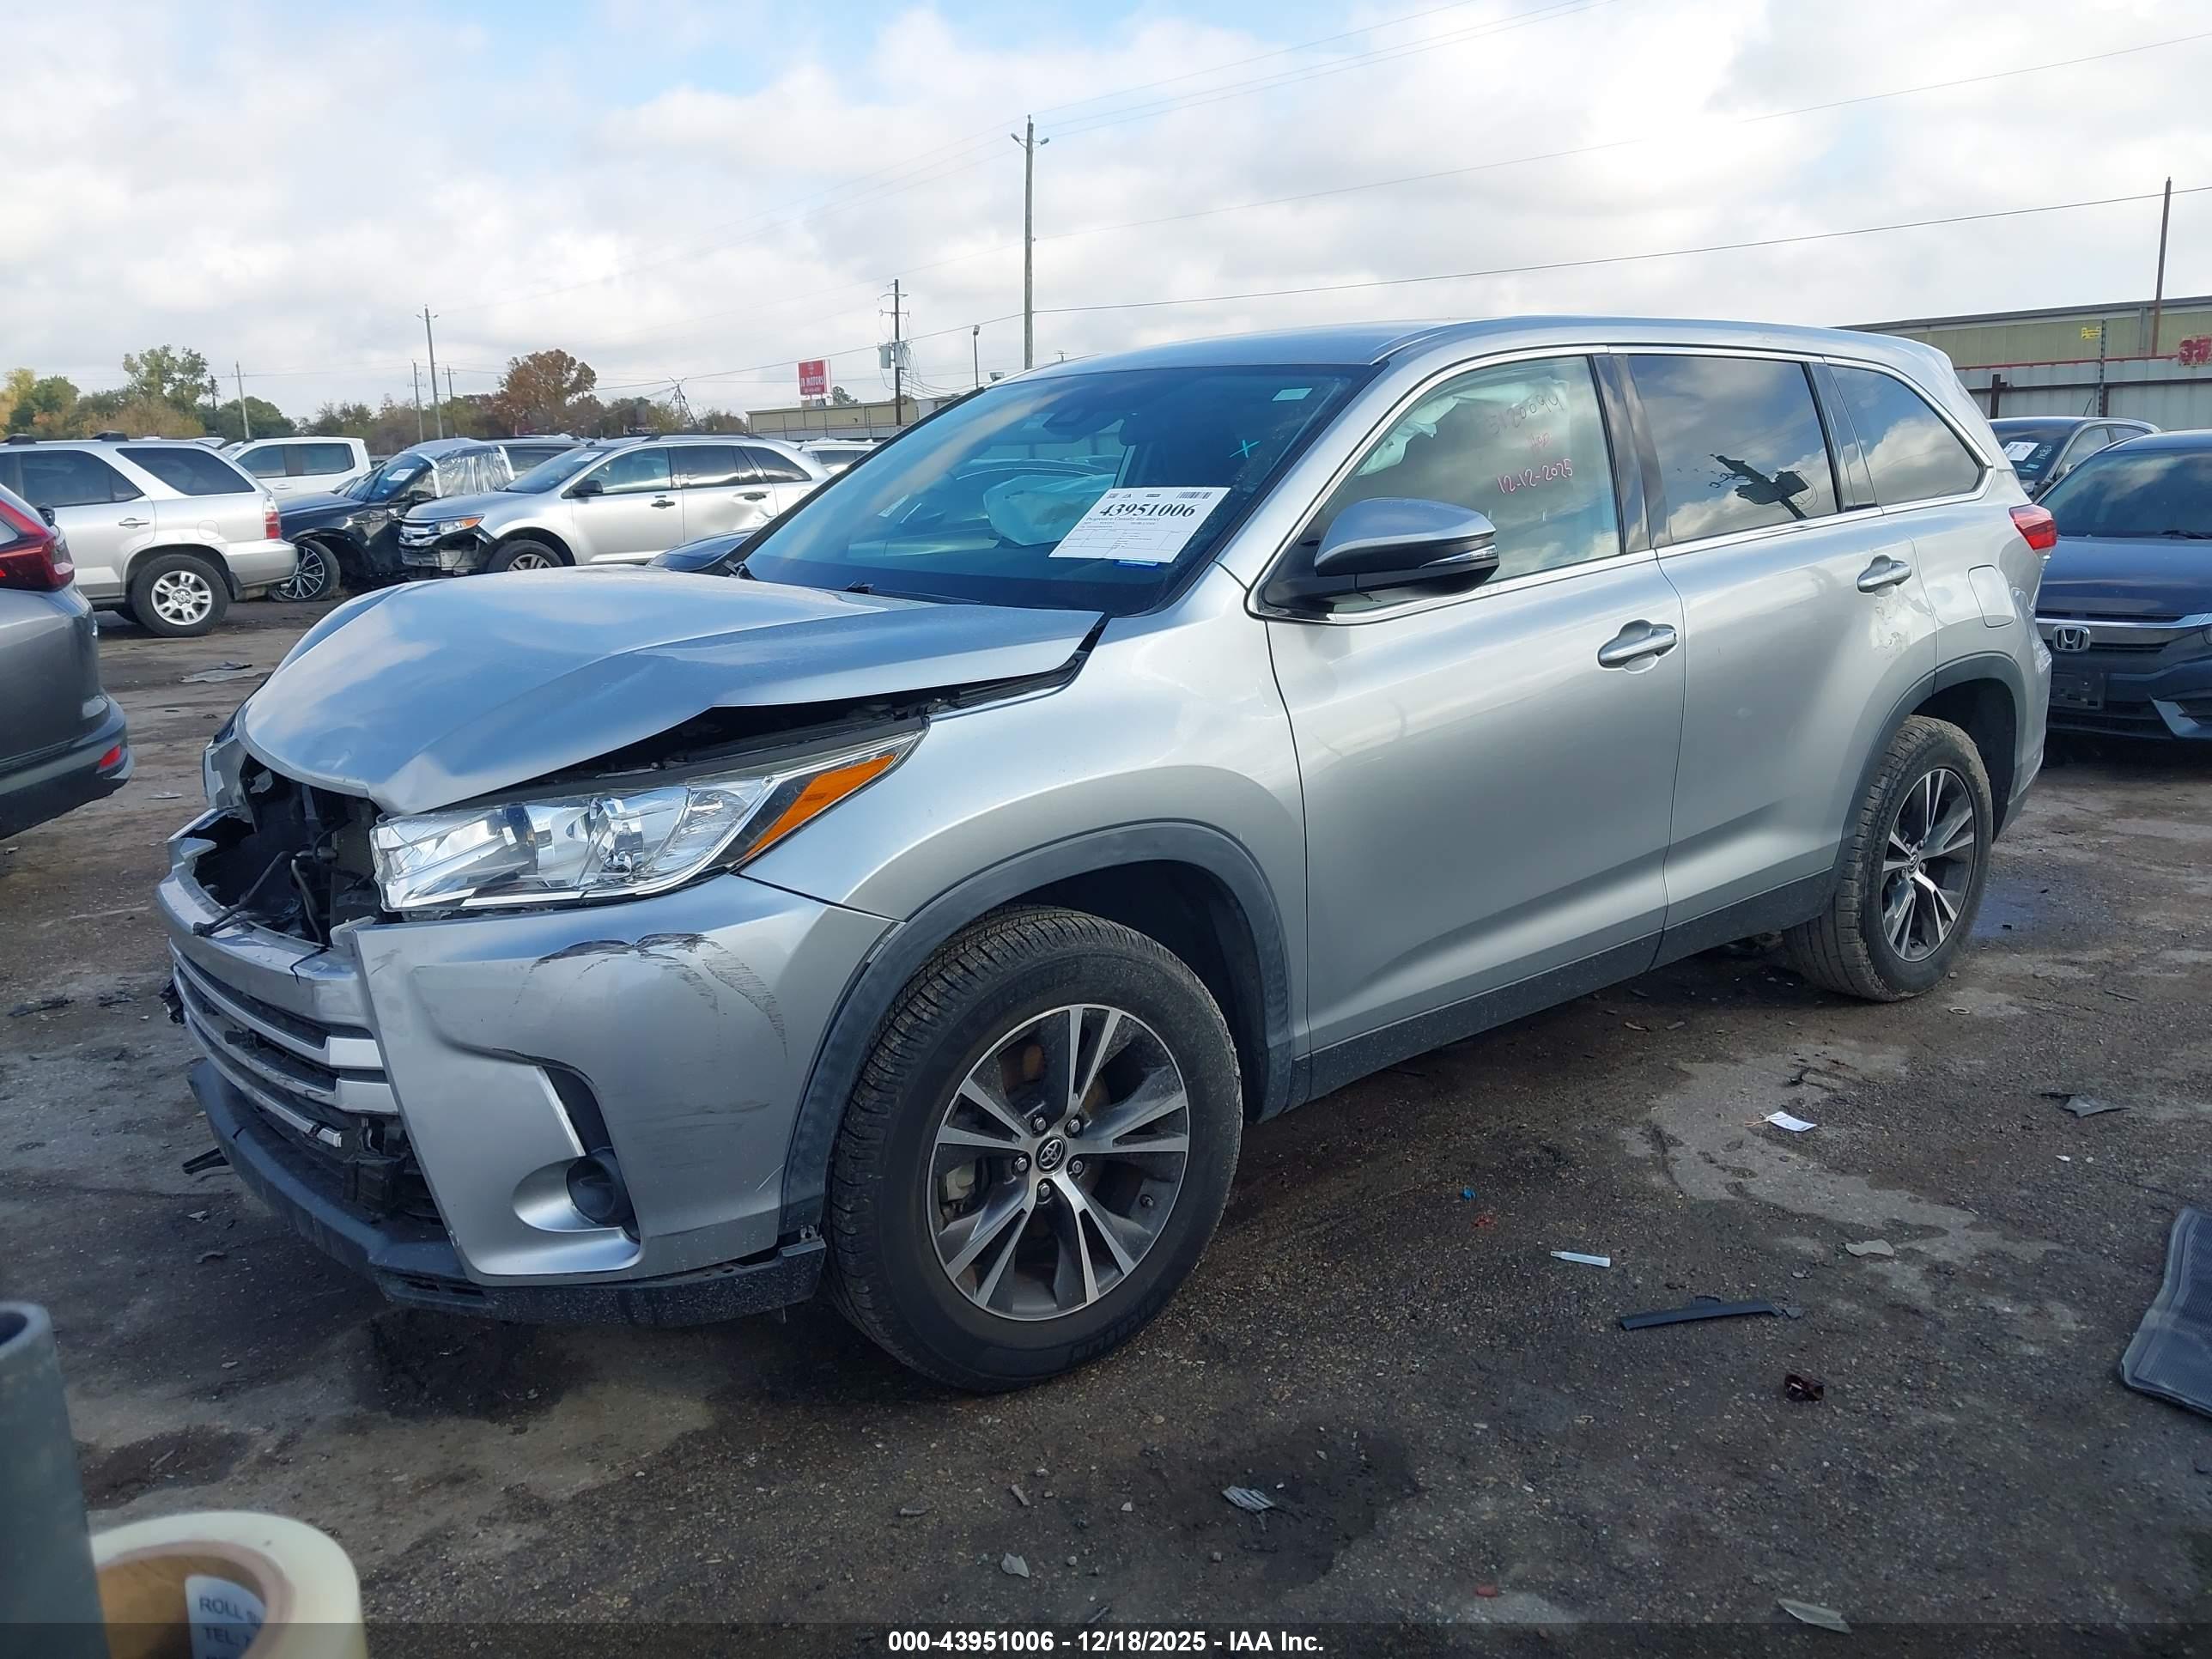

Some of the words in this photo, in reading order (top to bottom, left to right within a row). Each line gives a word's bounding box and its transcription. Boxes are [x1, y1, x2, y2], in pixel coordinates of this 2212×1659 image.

[1498, 459, 1573, 494] 12-12-2025
[1099, 503, 1200, 517] 43951006
[199, 1597, 242, 1620] ROLL
